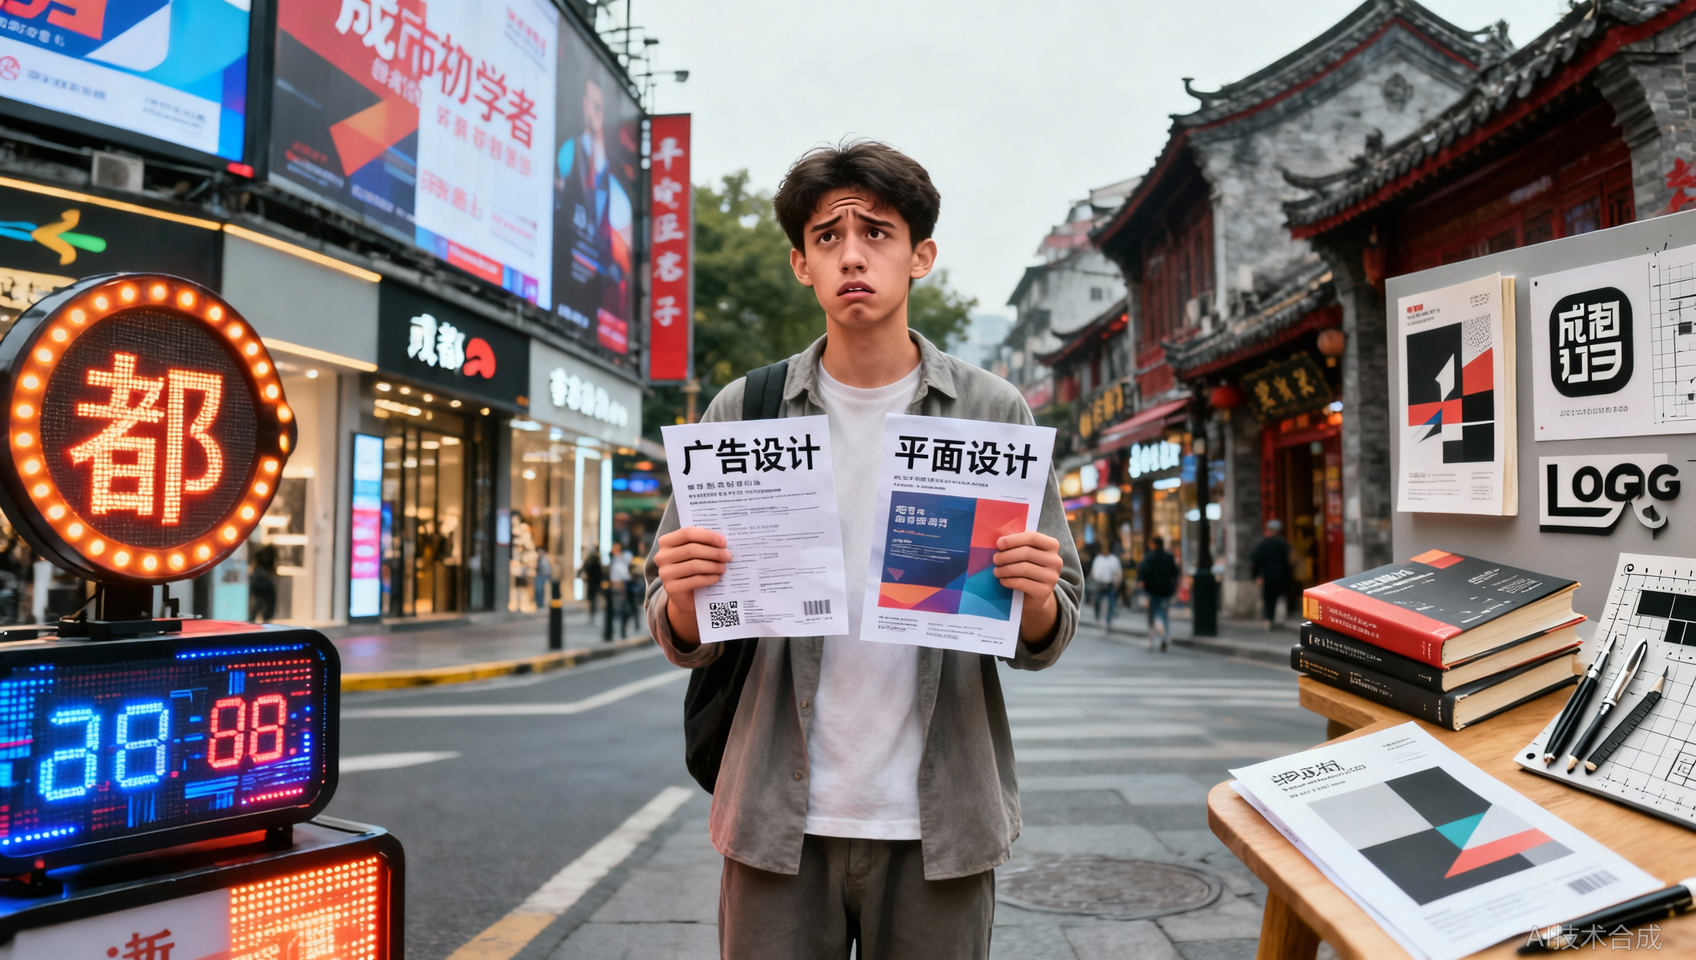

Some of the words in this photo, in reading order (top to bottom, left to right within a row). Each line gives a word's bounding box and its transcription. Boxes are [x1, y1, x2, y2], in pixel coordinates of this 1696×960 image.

[69, 351, 224, 526] 都
[682, 434, 820, 475] 广告设计
[895, 435, 1038, 479] 平面设计
